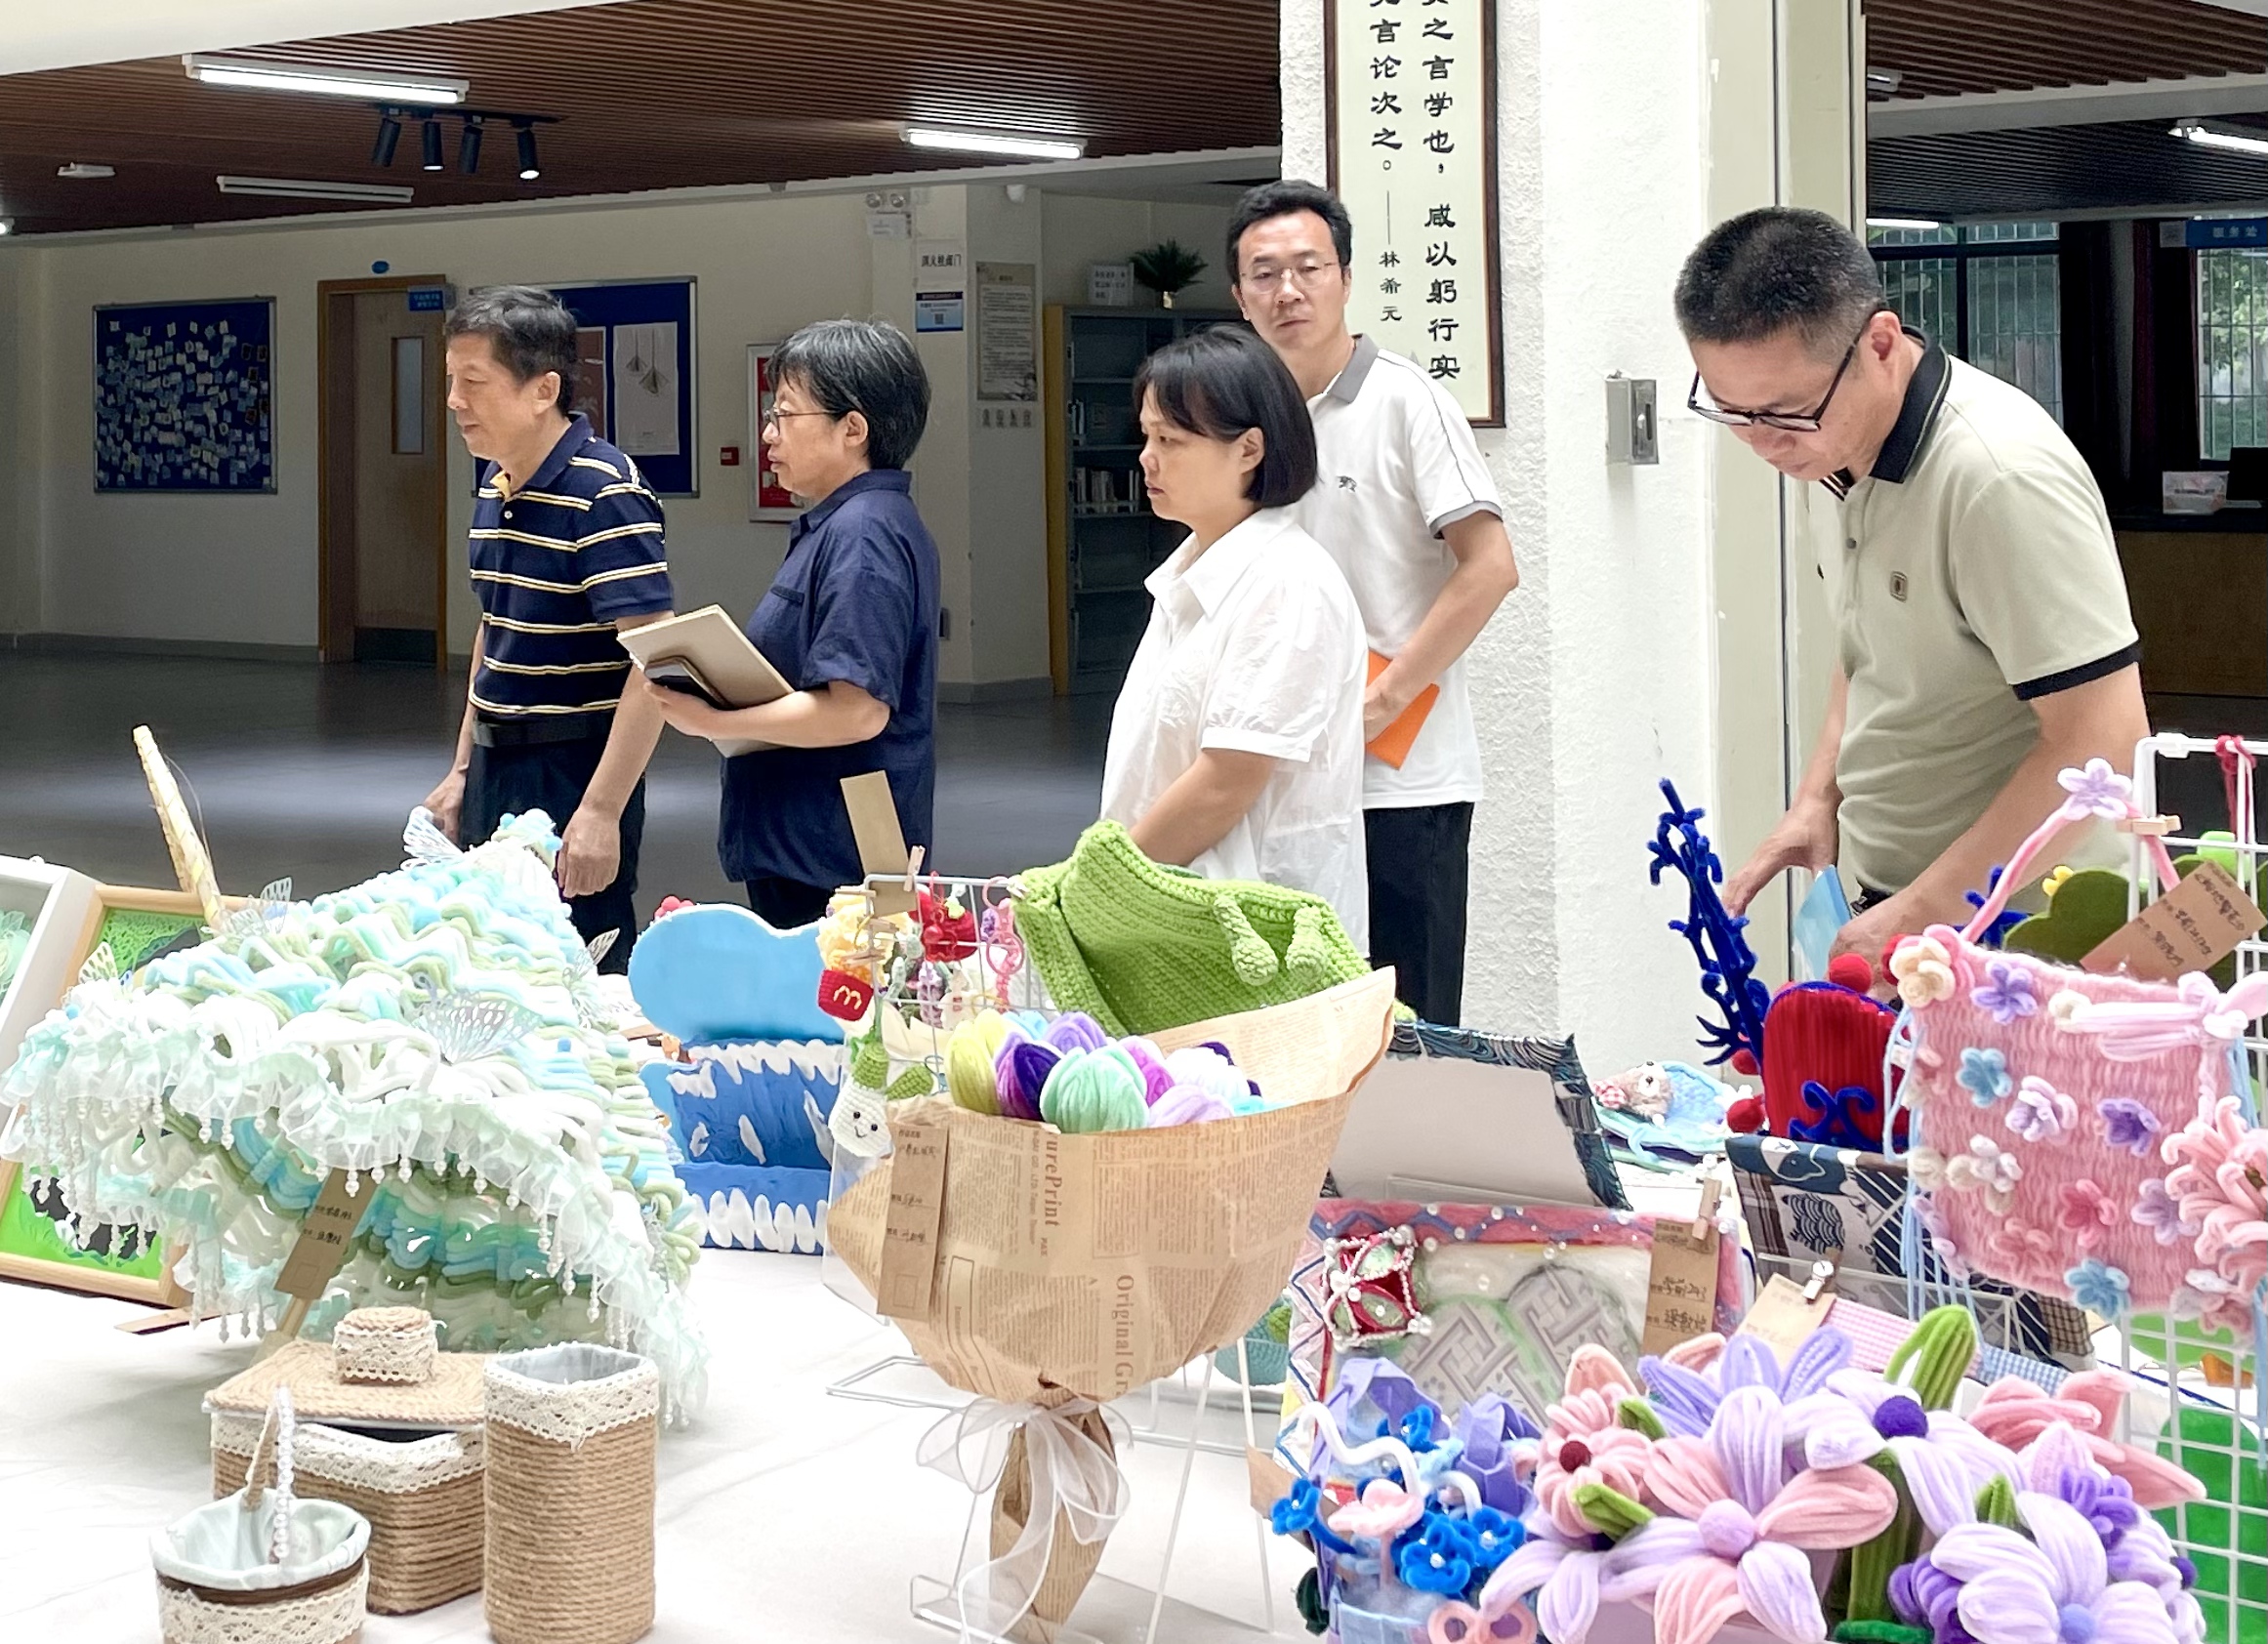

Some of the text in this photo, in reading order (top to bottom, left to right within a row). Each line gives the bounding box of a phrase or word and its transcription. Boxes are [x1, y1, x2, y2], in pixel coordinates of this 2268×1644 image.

[1369, 0, 1403, 171] 言论次之。
[1422, 0, 1462, 380] 之言学也，咸以躬行实
[1045, 1130, 1063, 1227] urePrint
[1111, 1274, 1134, 1357] Original
